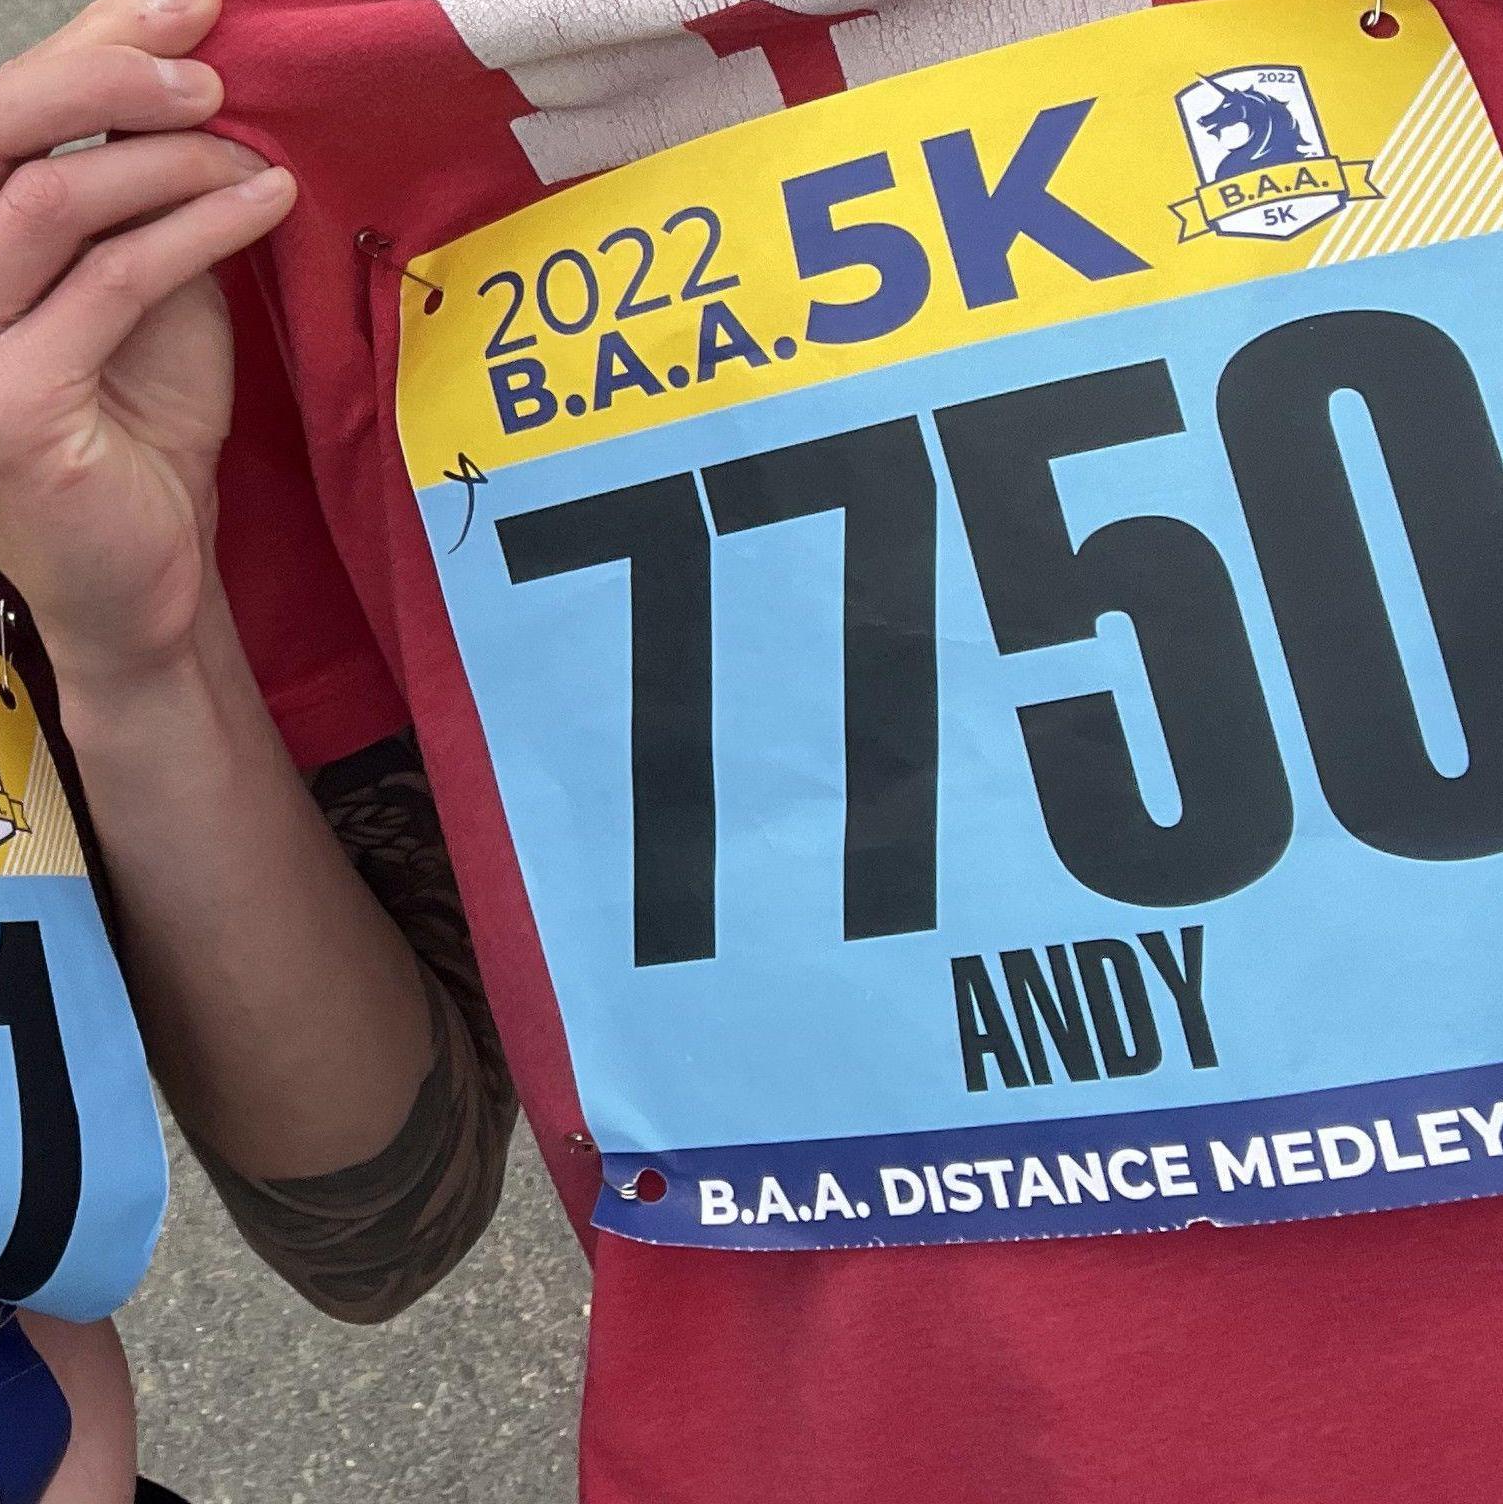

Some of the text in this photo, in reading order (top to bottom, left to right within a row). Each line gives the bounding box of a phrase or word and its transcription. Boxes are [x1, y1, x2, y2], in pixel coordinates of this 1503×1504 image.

[1258, 71, 1296, 84] 2022
[1218, 166, 1330, 208] B.A.A.
[1263, 204, 1299, 227] 5K
[477, 206, 739, 358] 2022
[489, 97, 1155, 436] B.A.A. 5K
[493, 308, 1503, 968] 7750
[950, 925, 1219, 1092] ANDY
[699, 1102, 1503, 1227] B.A.A. DISTANCE MEDLEY
